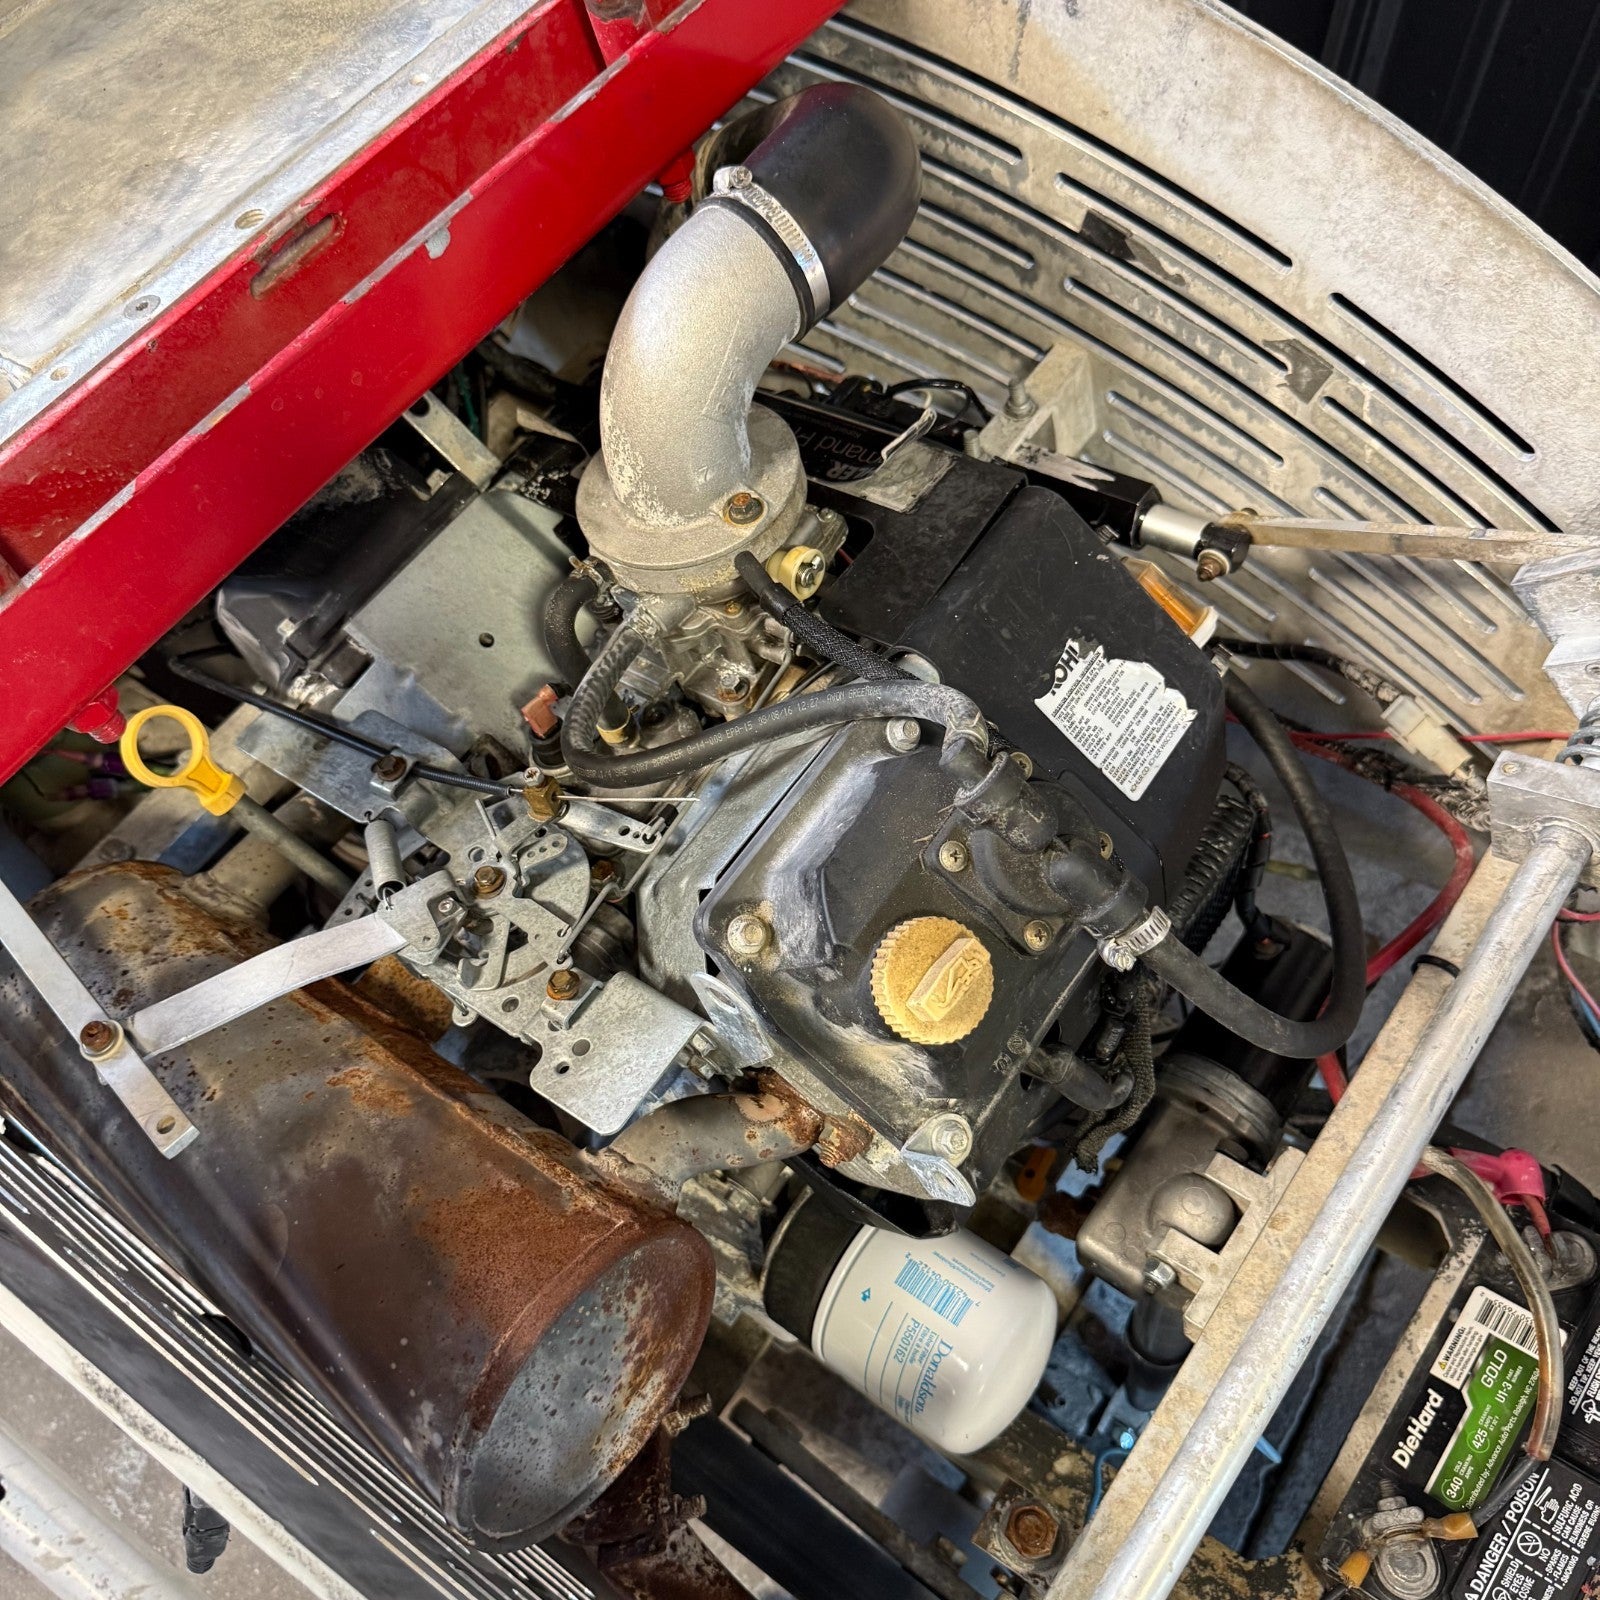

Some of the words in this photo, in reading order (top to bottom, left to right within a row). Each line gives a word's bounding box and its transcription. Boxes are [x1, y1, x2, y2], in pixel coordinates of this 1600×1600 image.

[1128, 774, 1143, 792] KOHLER
[1147, 748, 1162, 766] KOHLER
[1491, 1298, 1517, 1316] 76935
[893, 1318, 920, 1366] P550162
[1442, 1325, 1466, 1362] WARNING:
[1584, 1342, 1596, 1356] THE
[1479, 1348, 1509, 1388] GOLD
[1573, 1363, 1586, 1377] OUT
[1580, 1354, 1590, 1364] OF
[1584, 1357, 1597, 1373] KEEP
[1494, 1380, 1513, 1403] U1-3
[1566, 1374, 1580, 1391] KEEP
[1572, 1382, 1584, 1396] NOT
[1568, 1395, 1578, 1406] DO
[1388, 1386, 1445, 1469] DieHard
[1469, 1427, 1489, 1449] 425
[1463, 1476, 1486, 1509] Distributed
[1484, 1444, 1502, 1469] Advance
[1497, 1430, 1509, 1445] Auto
[1523, 1384, 1532, 1394] NC
[1444, 1475, 1464, 1499] 340
[1550, 1498, 1575, 1535] SULFURIC
[1566, 1481, 1583, 1501] ACID
[1468, 1531, 1509, 1592] DANGER
[1503, 1469, 1541, 1523] POISON
[1559, 1524, 1573, 1539] CAN
[1566, 1504, 1583, 1526] CAUSE
[1567, 1509, 1591, 1544] BLINDNESS
[1583, 1498, 1595, 1510] OR
[1575, 1524, 1594, 1549] SEVERE
[1537, 1546, 1552, 1562] NO
[1543, 1547, 1563, 1574] SPARKS
[1551, 1552, 1570, 1578] FLAMES
[1499, 1559, 1520, 1588] SHIELD
[1558, 1553, 1579, 1583] SMOKING
[1508, 1572, 1525, 1594] EYES
